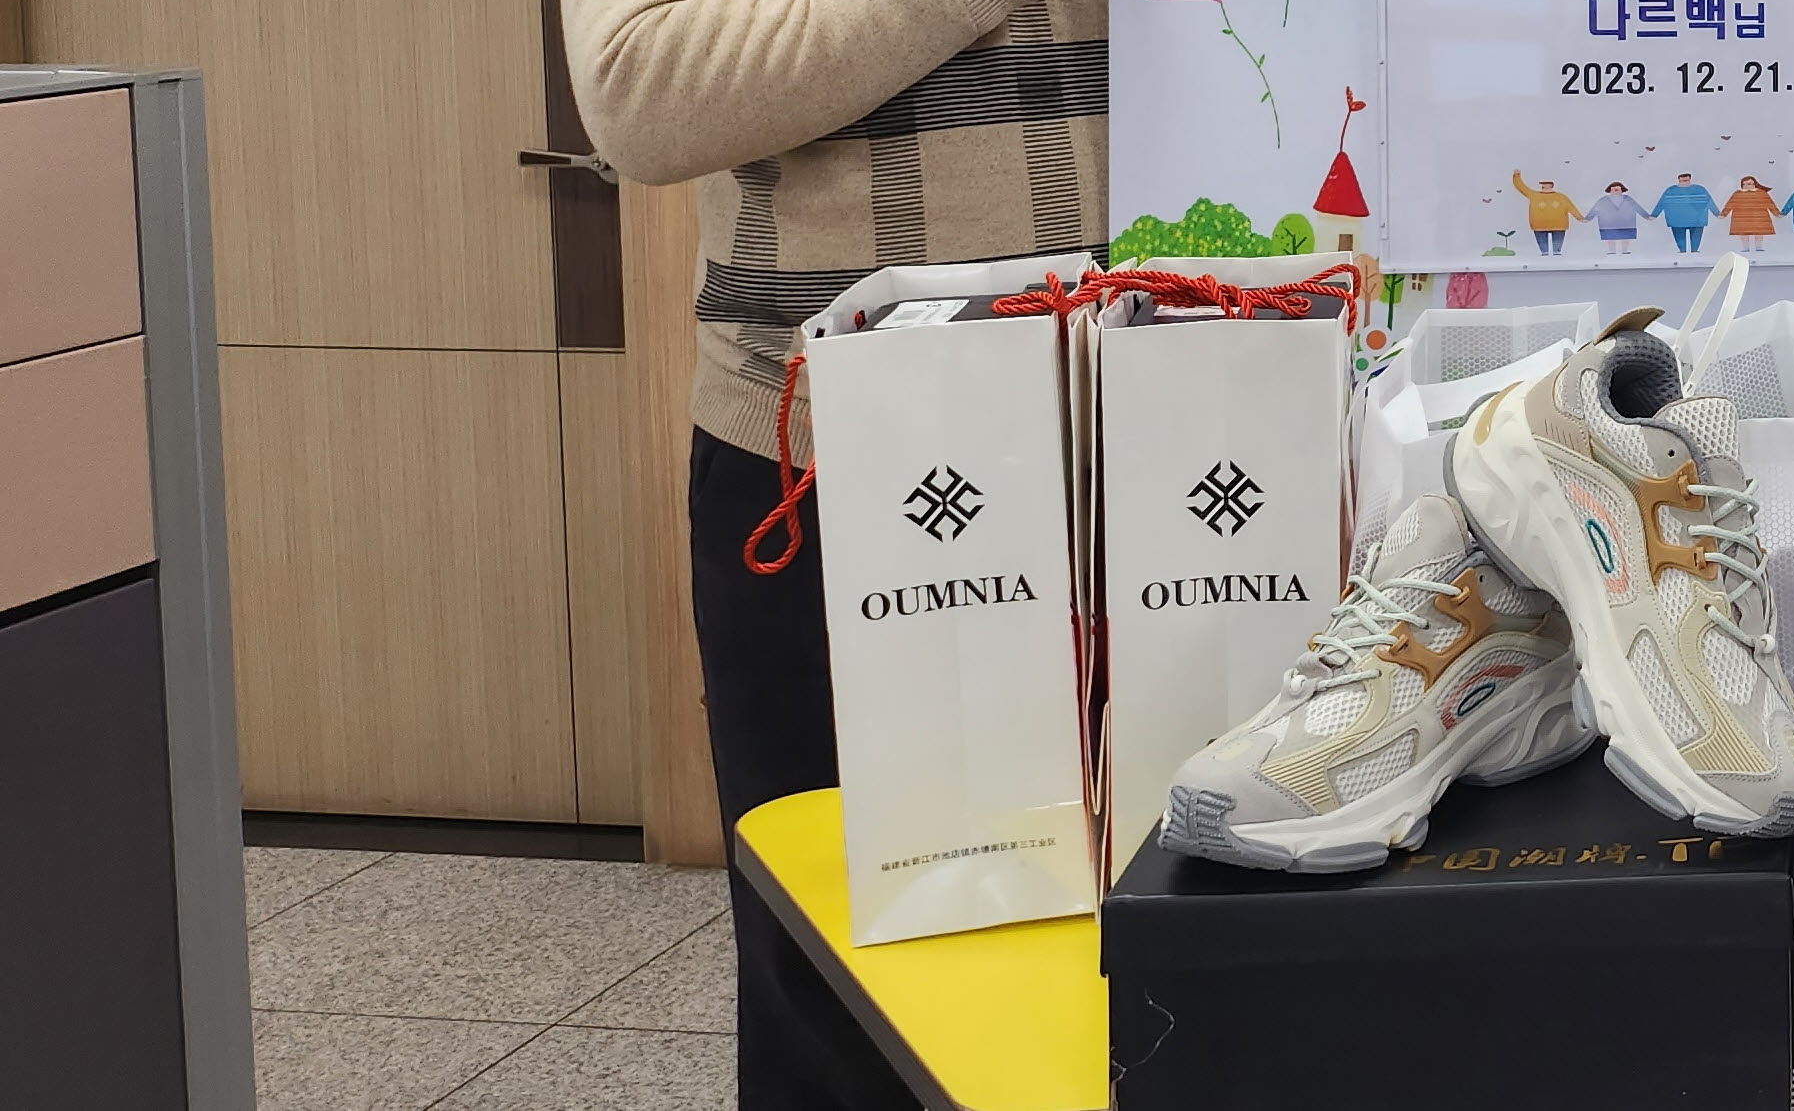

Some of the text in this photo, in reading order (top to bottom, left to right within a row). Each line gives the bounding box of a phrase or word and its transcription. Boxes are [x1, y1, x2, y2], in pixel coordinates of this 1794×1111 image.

[1561, 61, 1793, 95] 2023. 12. 21.
[861, 573, 1039, 621] OUMNIA
[1142, 573, 1311, 610] OUMNIA
